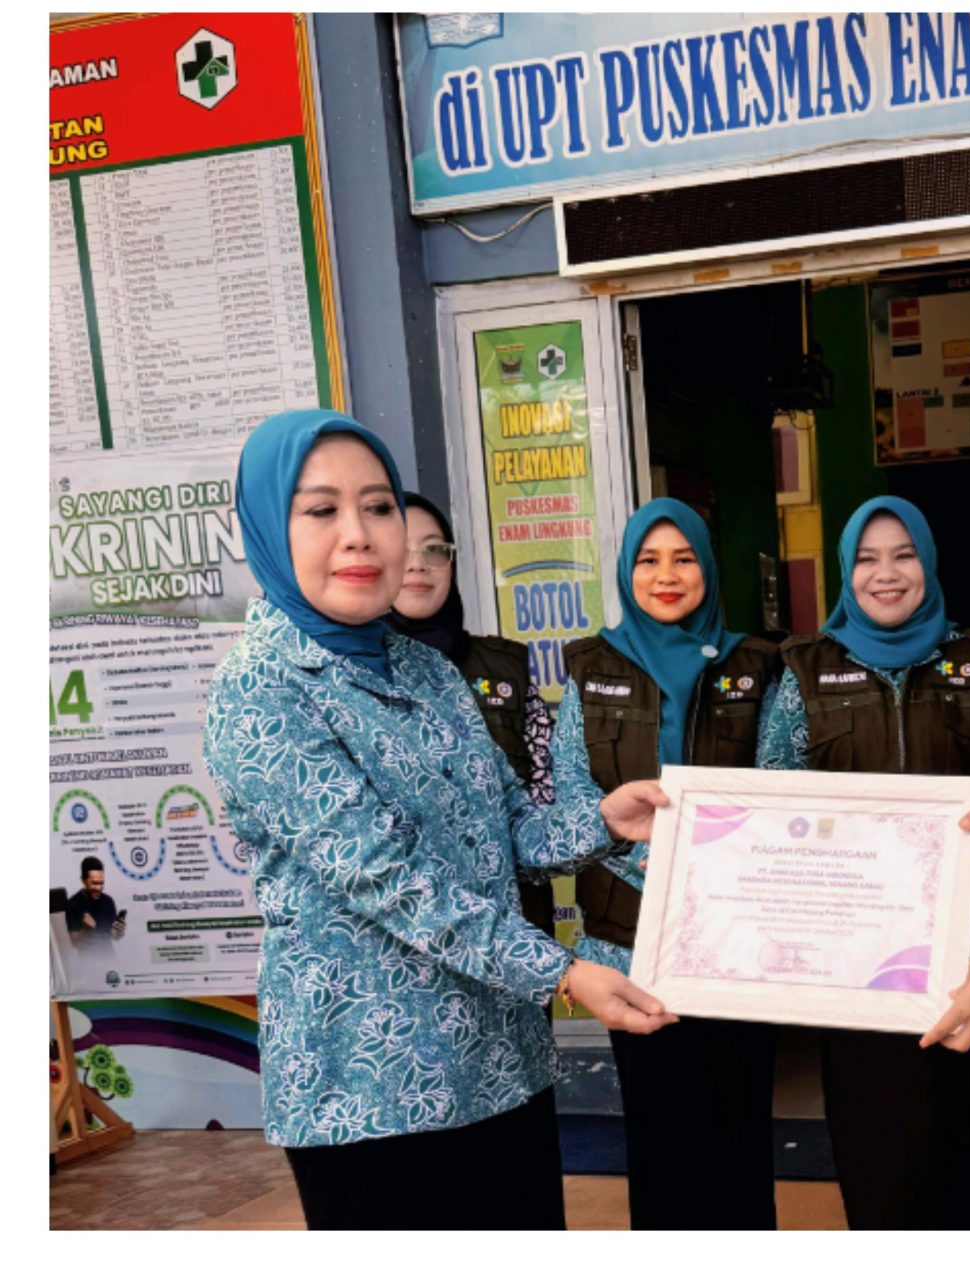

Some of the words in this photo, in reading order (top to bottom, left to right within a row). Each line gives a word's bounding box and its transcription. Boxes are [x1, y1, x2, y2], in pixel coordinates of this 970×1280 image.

[439, 71, 487, 171] di
[495, 56, 587, 162] UPT
[599, 12, 872, 148] PUSKESMAS
[500, 400, 572, 439] INOVASI
[493, 444, 587, 485] PELAYANAN
[59, 486, 171, 519] SAYANGI
[178, 479, 231, 507] DIRI
[506, 494, 578, 517] PUSKESMAS
[50, 510, 247, 579] KRININ
[498, 523, 530, 543] ENAM
[532, 518, 593, 542] LINGKUNG
[93, 575, 166, 607] SEJAK
[169, 570, 223, 600] DINI
[513, 580, 589, 631] BOTOL
